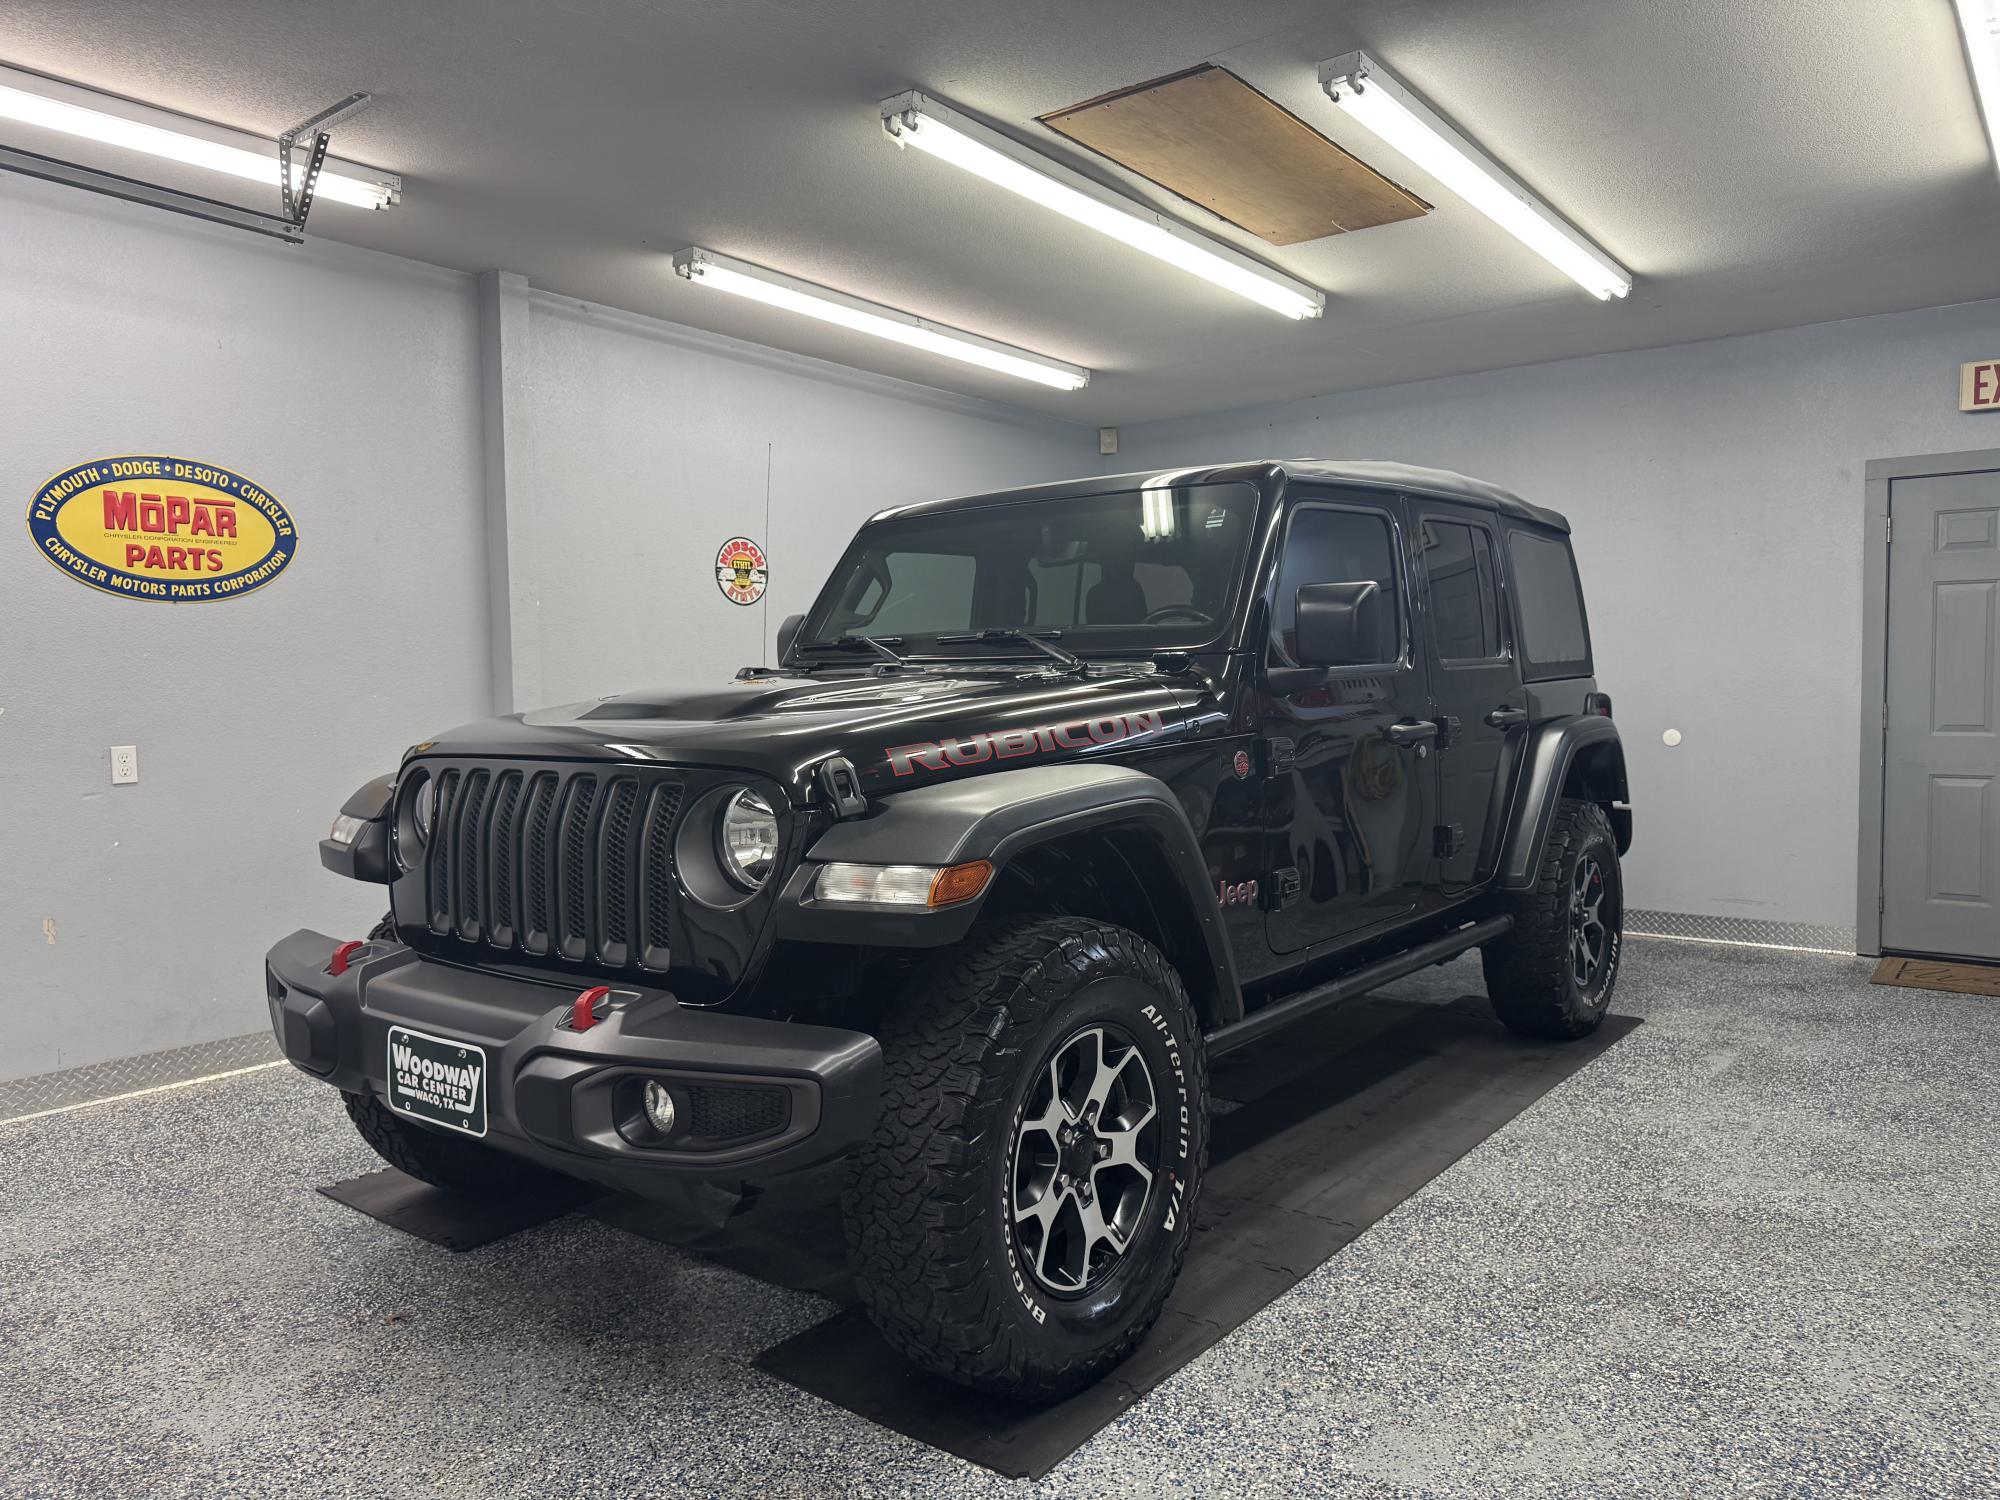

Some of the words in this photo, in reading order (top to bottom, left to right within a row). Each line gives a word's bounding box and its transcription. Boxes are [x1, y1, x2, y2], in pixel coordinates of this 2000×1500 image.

[36, 467, 101, 520] PLYMOUTH
[112, 461, 161, 477] DODGE
[240, 484, 292, 537] CHRYSLER
[103, 532, 142, 540] CHRYSLER
[143, 535, 193, 543] CORPORATION
[45, 537, 106, 582] CHRYSLER
[110, 574, 166, 596] MOTORS
[171, 583, 210, 596] PARTS
[214, 550, 287, 593] CORPORATION
[125, 543, 223, 571] PARTS
[727, 586, 761, 602] ETHYL
[885, 711, 1164, 777] RUBICON
[1216, 879, 1259, 908] Jeep
[392, 1043, 481, 1090] WOODWAY
[1140, 1004, 1188, 1159] All-Terrain
[397, 1071, 419, 1088] CAR
[422, 1078, 467, 1101] CENTER
[415, 1089, 443, 1108] WACO,
[443, 1098, 455, 1110] TX
[1163, 1178, 1185, 1232] T/A
